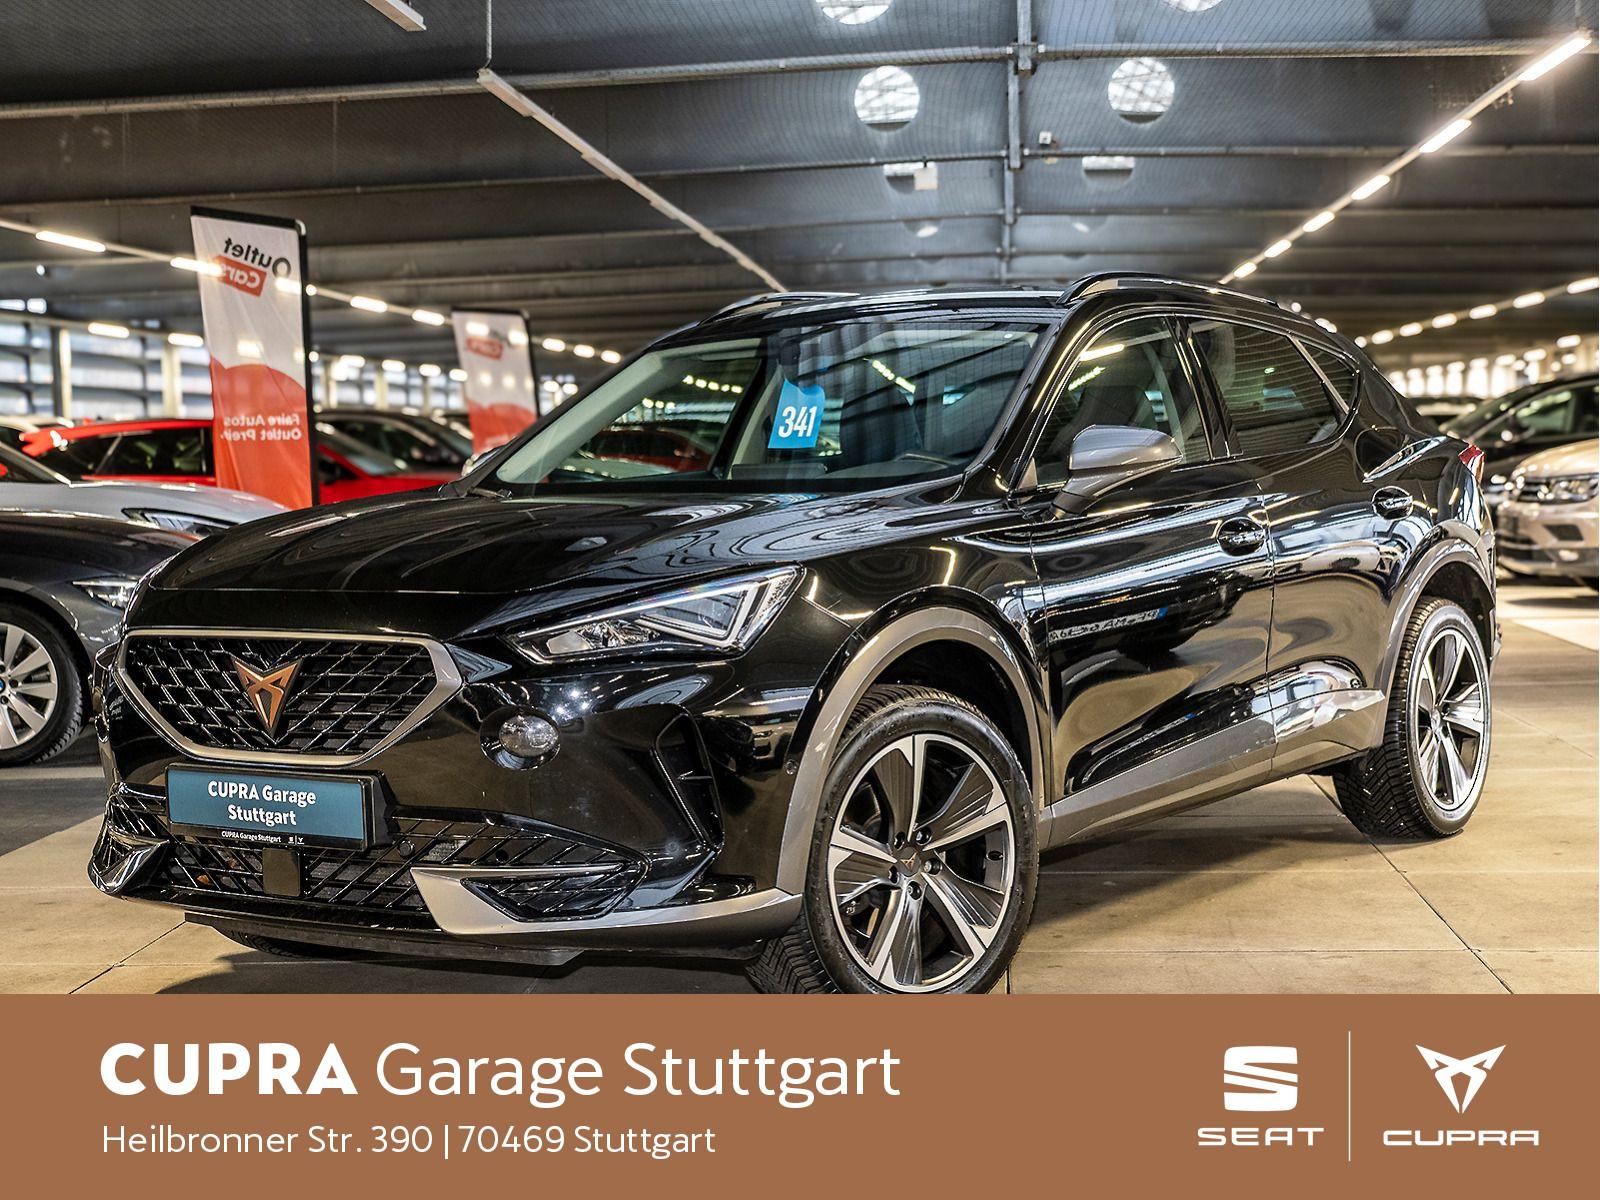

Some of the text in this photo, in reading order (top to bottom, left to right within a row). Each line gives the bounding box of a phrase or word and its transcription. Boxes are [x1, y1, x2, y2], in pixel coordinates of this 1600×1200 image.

[778, 405, 818, 438] 341
[207, 780, 317, 808] CUPRA Garage
[227, 804, 297, 827] Stuttgart
[221, 830, 239, 839] CUPRA
[240, 832, 258, 841] Garage
[257, 834, 282, 843] Stuttgart
